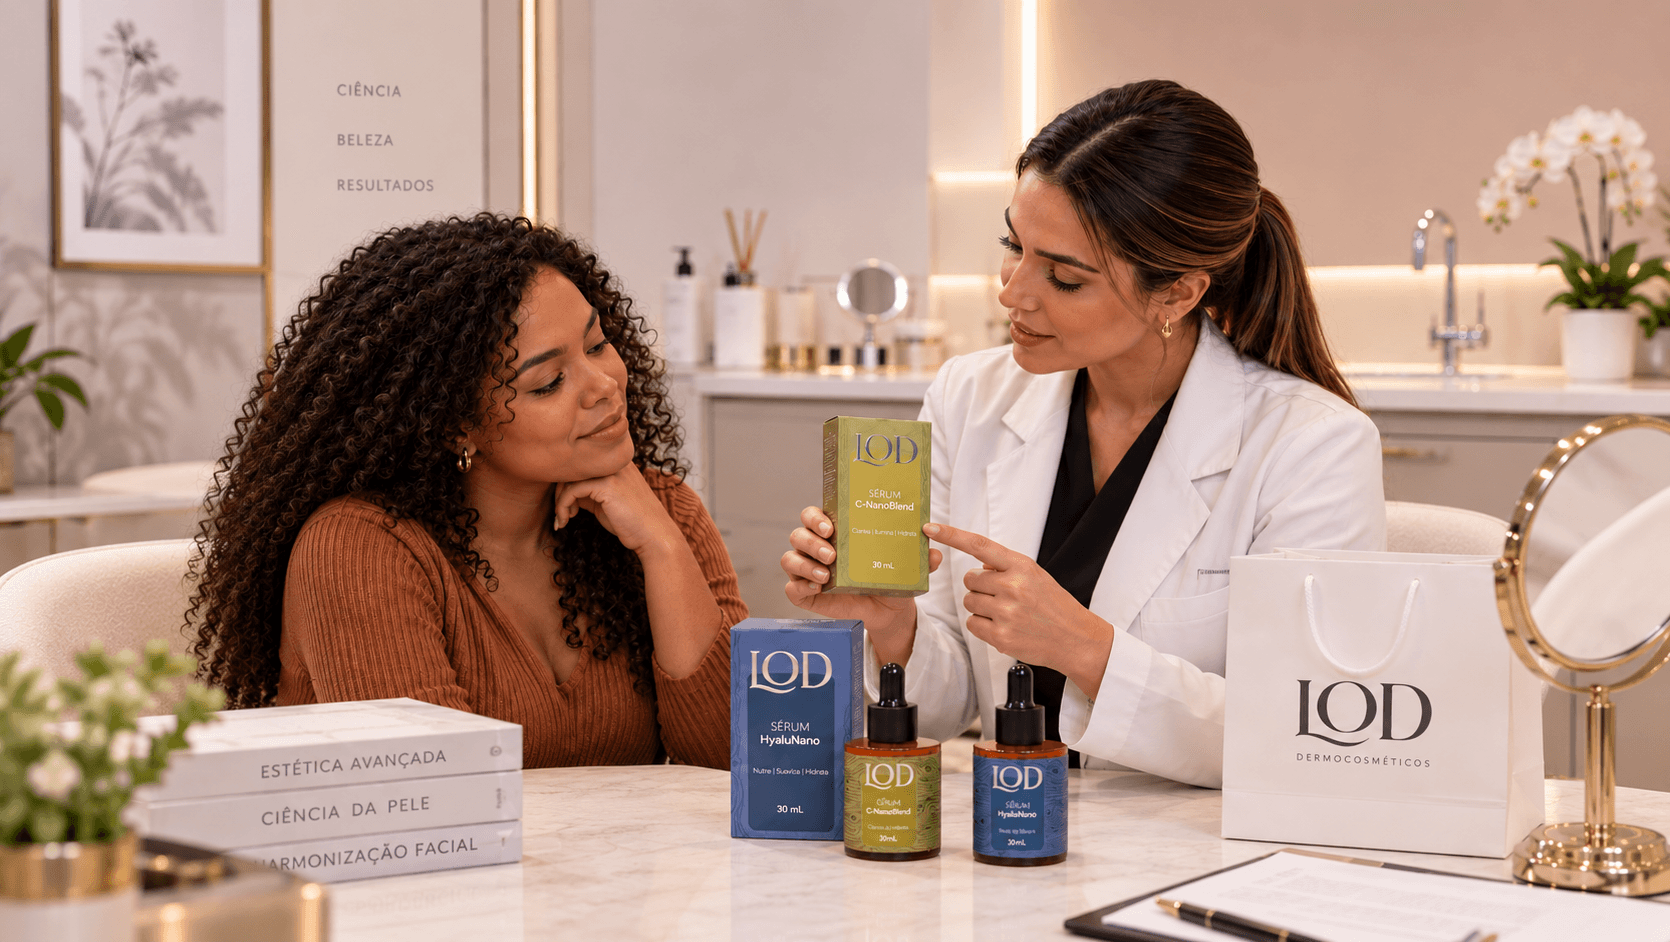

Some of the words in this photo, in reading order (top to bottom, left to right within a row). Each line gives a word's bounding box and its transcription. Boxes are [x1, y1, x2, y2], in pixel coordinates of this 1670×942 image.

[336, 81, 402, 98] CIÊNCIA
[336, 133, 394, 146] BELEZA
[336, 179, 434, 192] RESULTADOS
[852, 432, 919, 467] LOD
[868, 488, 902, 499] SÉRUM
[855, 500, 915, 511] C-NanoBlend
[872, 561, 882, 569] 30
[882, 562, 895, 570] mL
[749, 650, 833, 694] LOD
[1295, 679, 1433, 747] LOD
[770, 719, 810, 732] SÉRUM
[760, 734, 821, 747] HyaluNano
[261, 758, 344, 779] ESTÉTICA
[350, 750, 447, 769] AVANÇADA
[1296, 752, 1431, 768] DERMOCOSMÉTICOS
[864, 763, 915, 790] LOD
[992, 765, 1044, 793] LOD
[261, 806, 340, 826] CIÊNCIA
[352, 802, 377, 817] DA
[388, 796, 430, 813] PELE
[776, 805, 788, 813] 30
[790, 805, 804, 814] mL
[254, 843, 408, 870] ARMONIZAÇÃO
[415, 837, 478, 857] FACIAL
